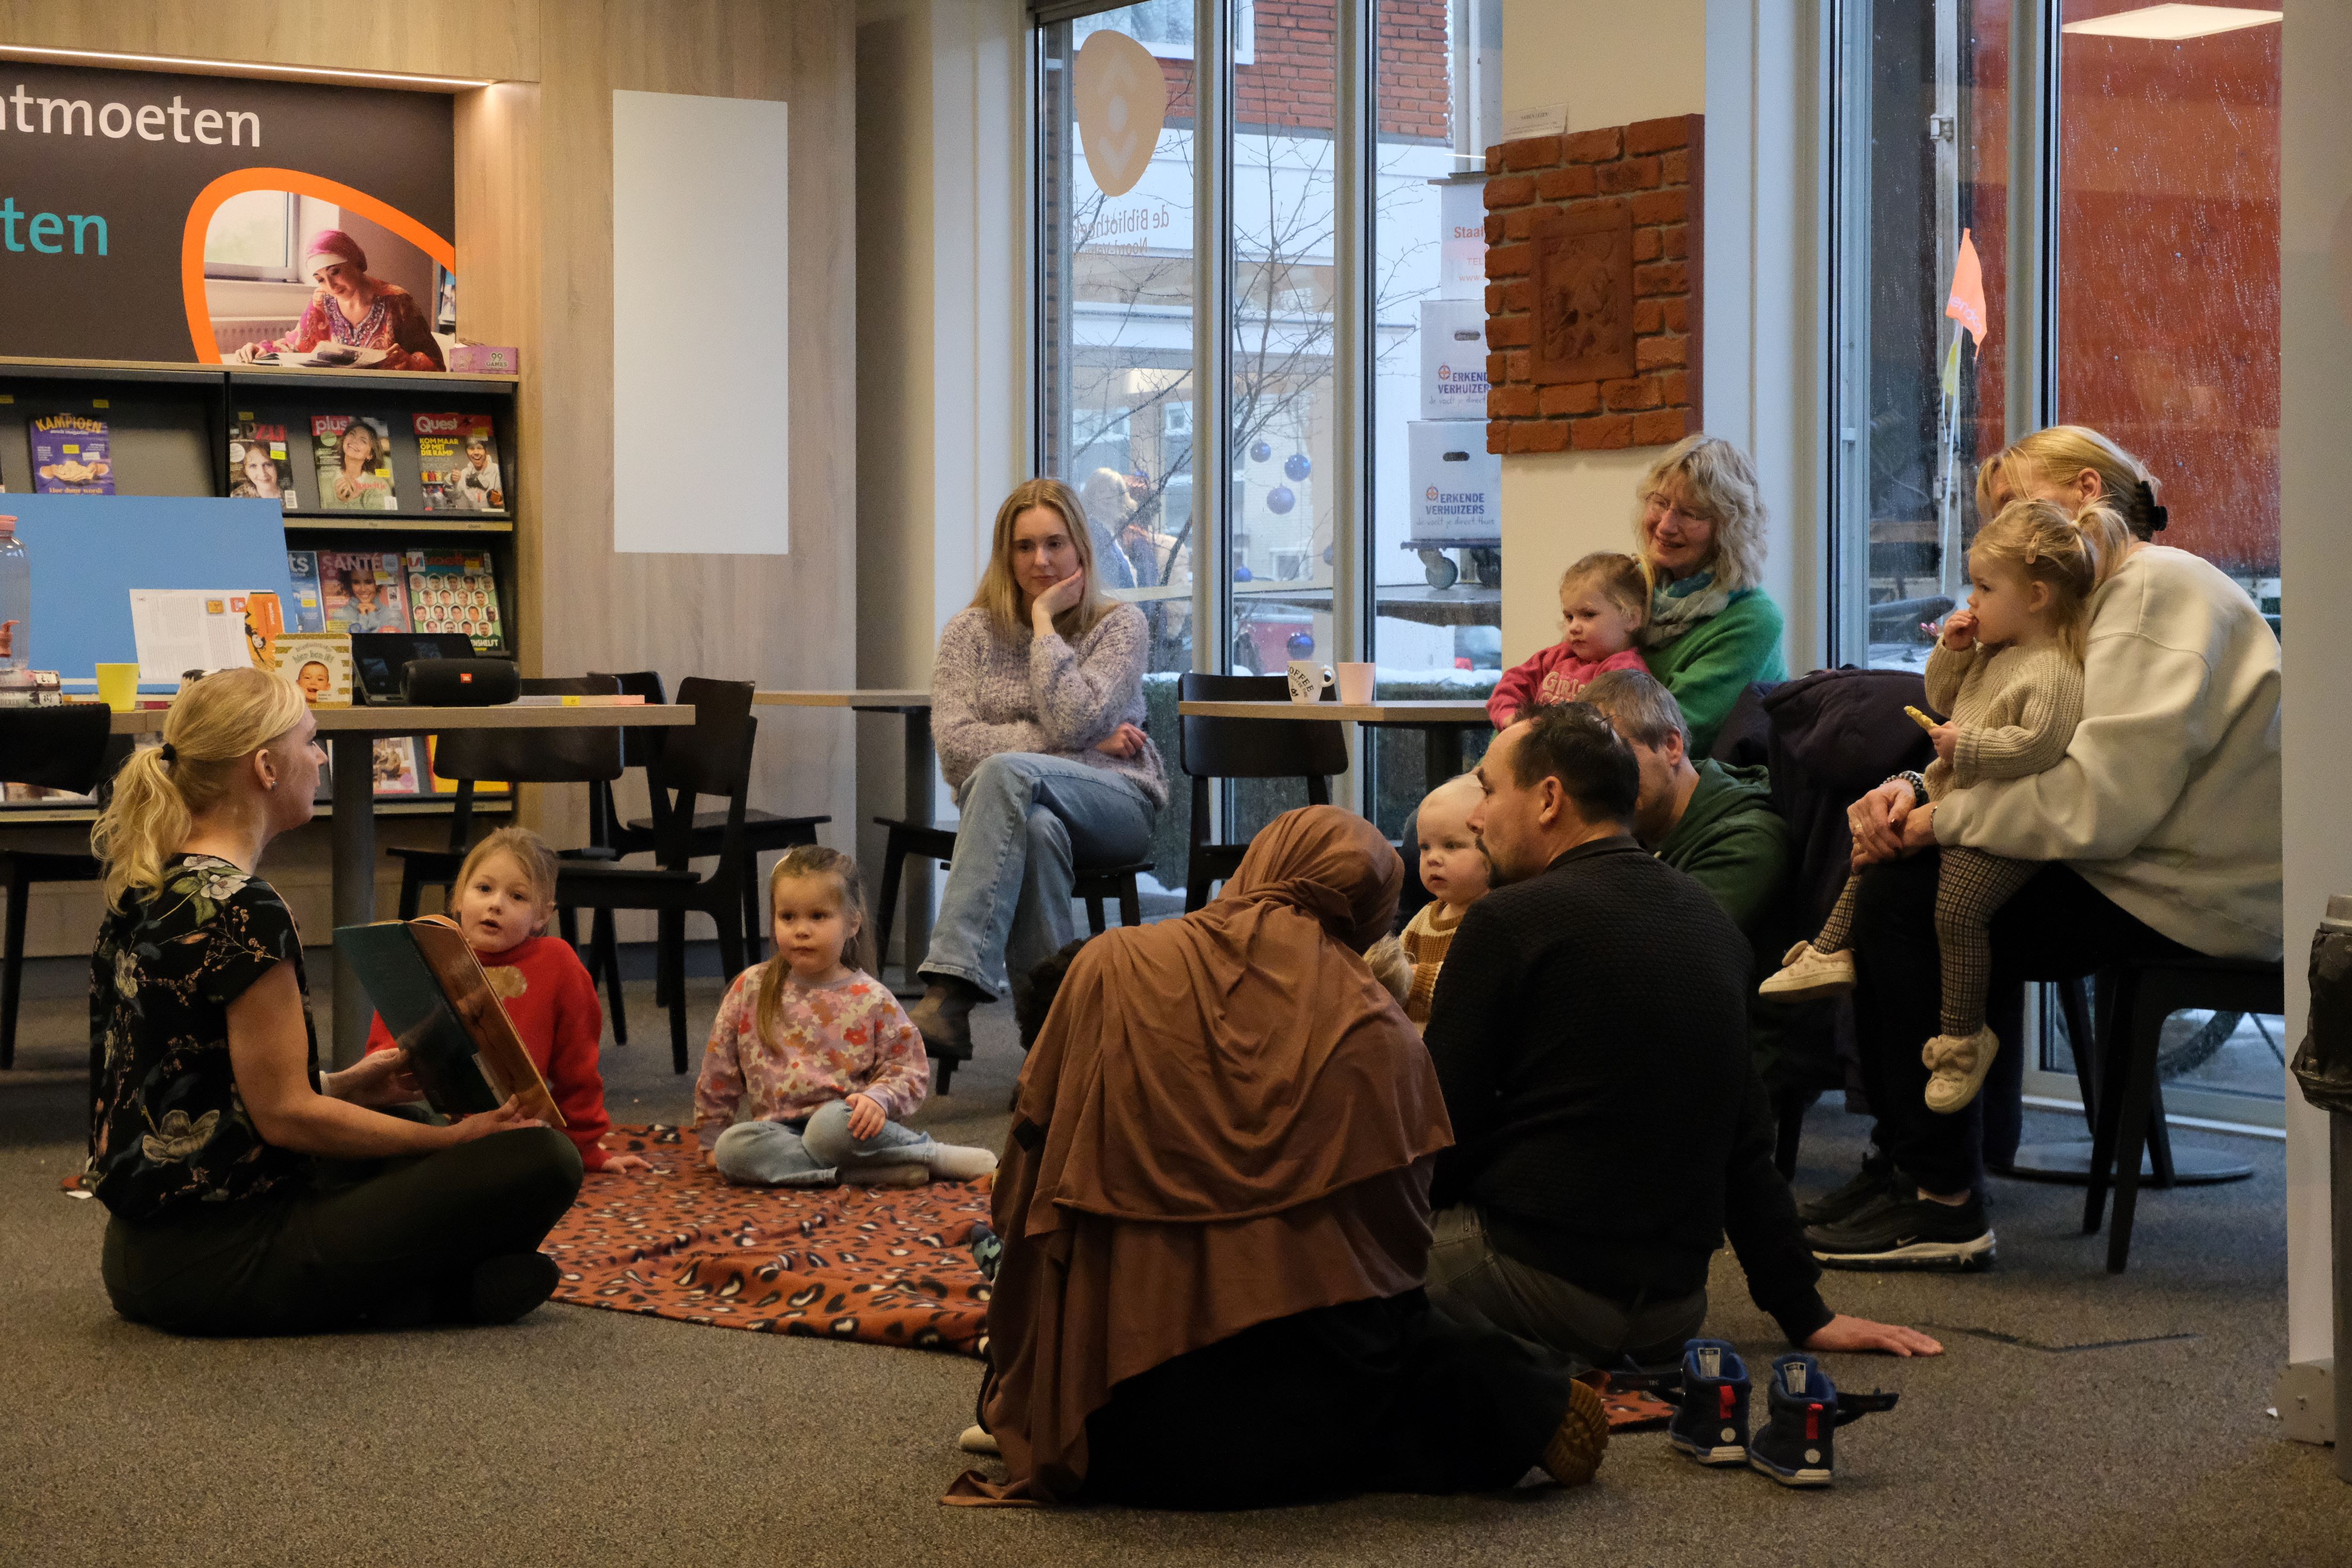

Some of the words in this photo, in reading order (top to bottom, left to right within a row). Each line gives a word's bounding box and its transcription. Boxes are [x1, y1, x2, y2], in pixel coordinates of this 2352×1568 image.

[0, 84, 260, 147] tmoeten
[491, 353, 503, 362] 99
[36, 416, 102, 434] KAMPIOEN
[315, 415, 347, 435] plus
[416, 415, 458, 433] Quest
[1440, 493, 1484, 503] ERKENDE
[1426, 505, 1485, 515] VERHUIZERS
[322, 552, 382, 571] SANTÉ
